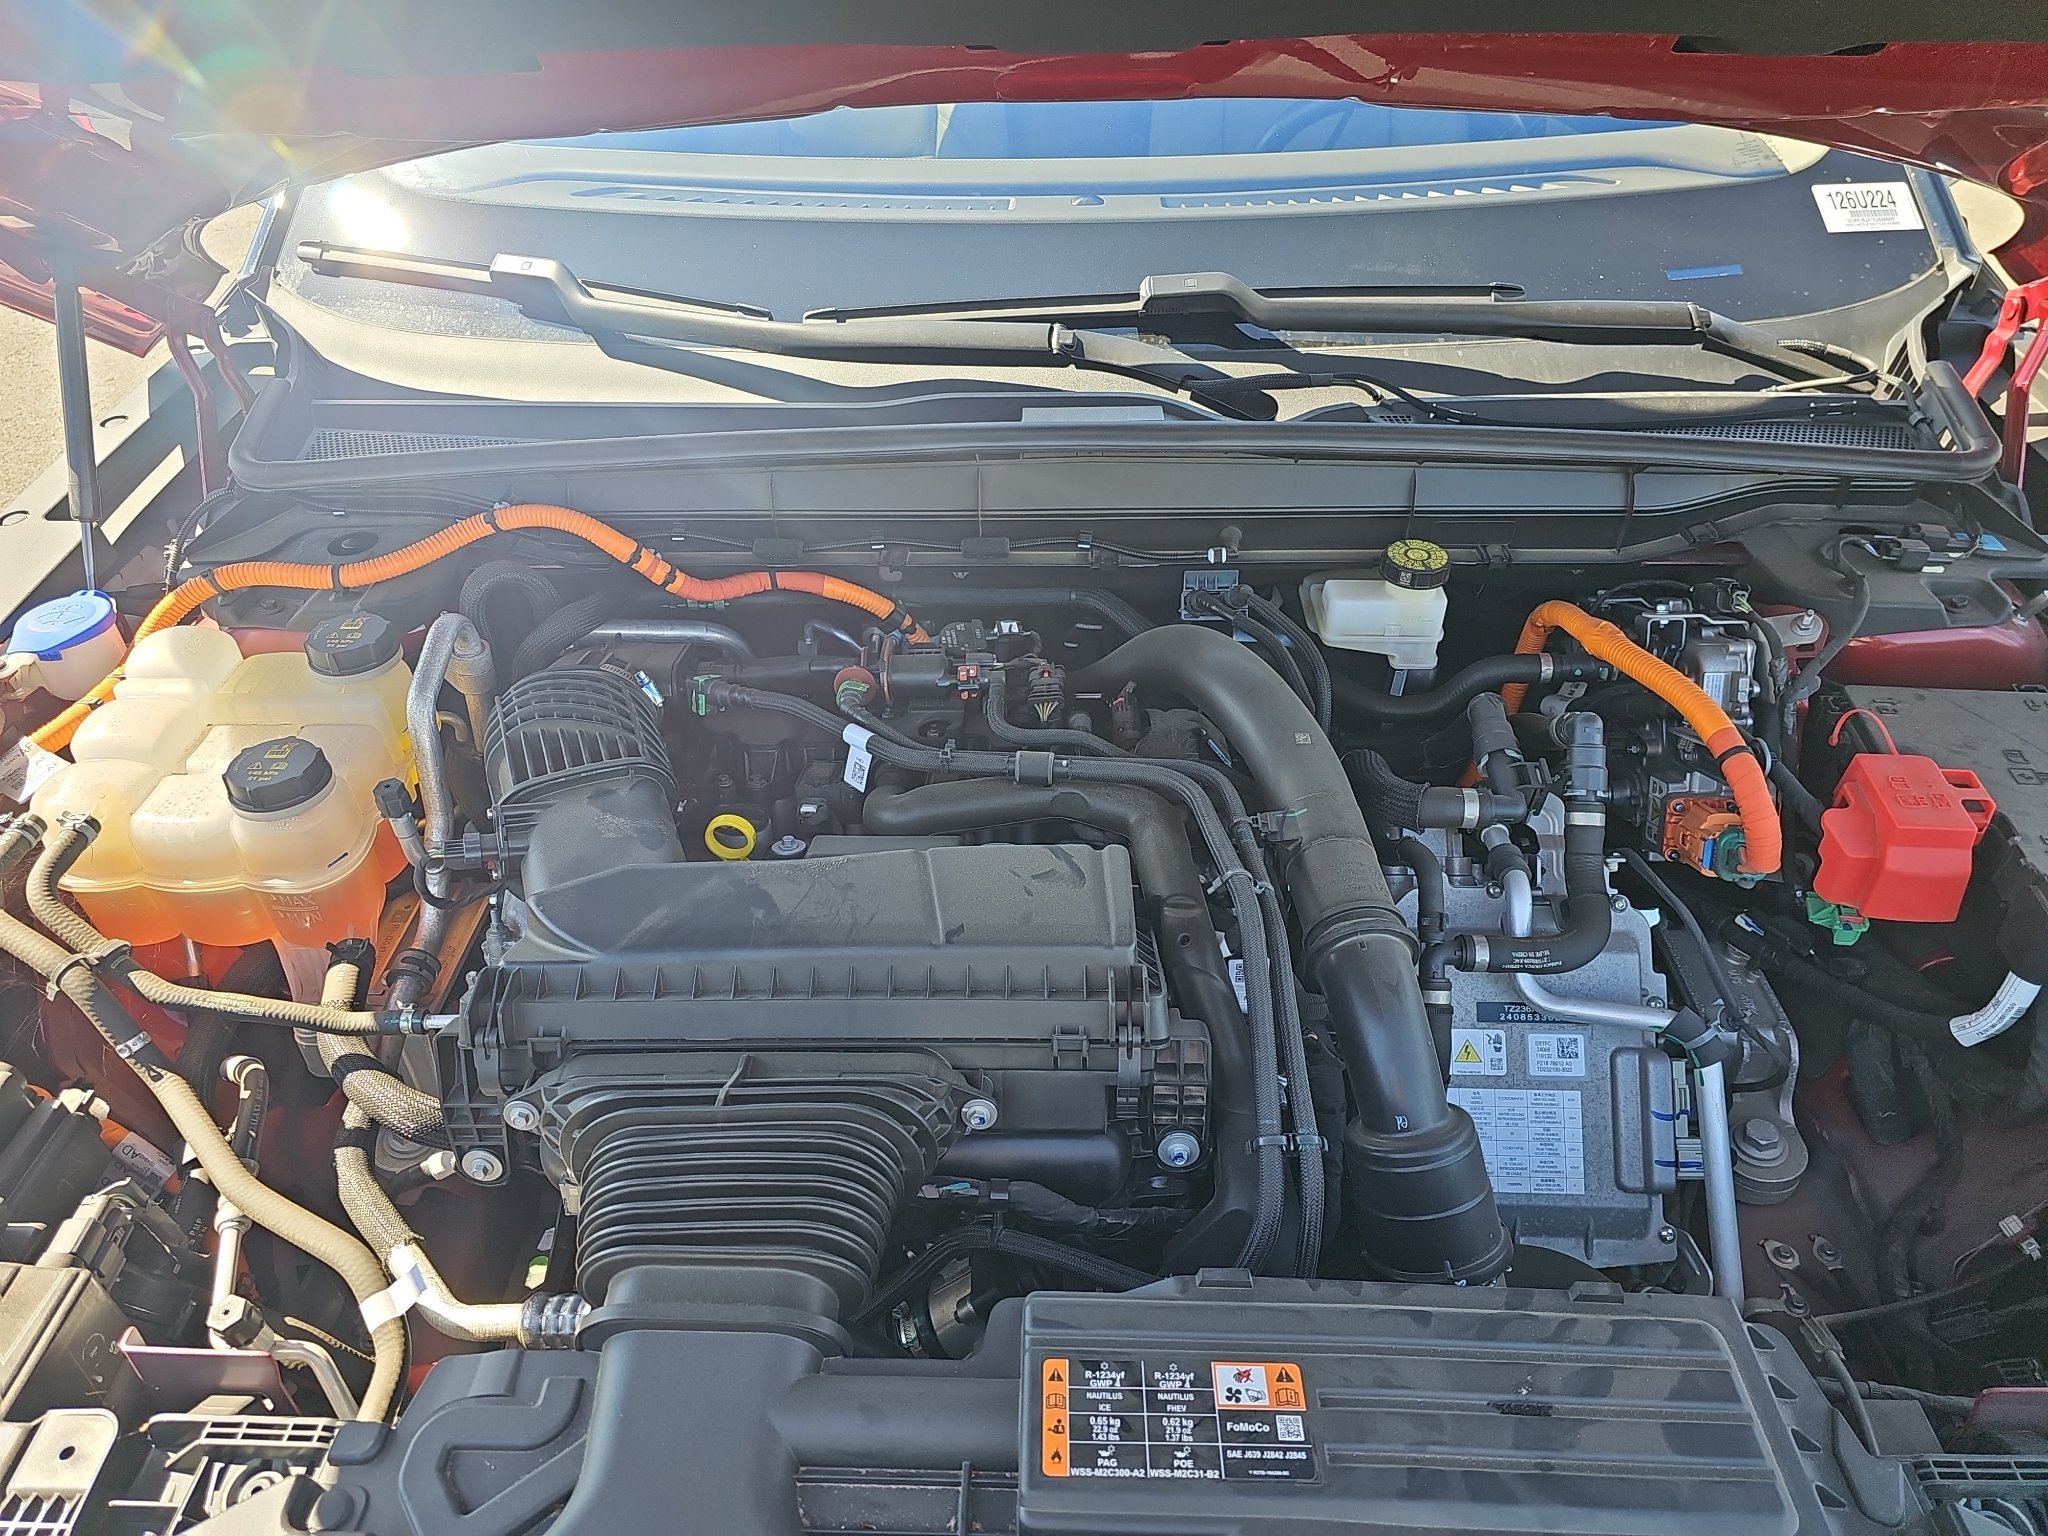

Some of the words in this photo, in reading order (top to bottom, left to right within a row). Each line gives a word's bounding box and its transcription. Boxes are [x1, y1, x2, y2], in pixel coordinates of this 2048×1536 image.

[1826, 189, 1897, 210] 126U224
[280, 895, 317, 906] MAX
[1504, 1005, 1535, 1013] TZ236
[121, 1144, 138, 1160] AD
[1085, 1370, 1126, 1381] R-1234yf
[1154, 1371, 1194, 1382] R-1234yf
[1090, 1380, 1112, 1388] GWP
[1114, 1380, 1120, 1388] 4
[1159, 1380, 1182, 1389] GWP
[1184, 1380, 1190, 1389] 4
[1086, 1392, 1124, 1400] NAUTILUS
[1157, 1392, 1194, 1401] NAUTILUS
[1098, 1404, 1112, 1412] ICE
[1166, 1404, 1187, 1412] FHEV
[1089, 1417, 1110, 1426] 0.65
[1110, 1417, 1120, 1428] kg
[1162, 1418, 1182, 1426] 0.62
[1184, 1418, 1194, 1428] kg
[1226, 1422, 1270, 1432] FoMoCo
[1165, 1426, 1182, 1434] 21.9
[1108, 1434, 1120, 1442] lbs
[1165, 1434, 1180, 1442] 1.37
[1181, 1434, 1194, 1442] lbs
[1226, 1450, 1242, 1458] SAE
[1243, 1450, 1262, 1459] J639
[1262, 1451, 1284, 1460] J2842
[1284, 1452, 1307, 1460] J2845
[1098, 1458, 1118, 1467] PAG
[1173, 1458, 1194, 1468] POE
[1070, 1468, 1146, 1478] WSS-M2C300-A2
[1150, 1468, 1220, 1478] WSS-M2C31-B2
